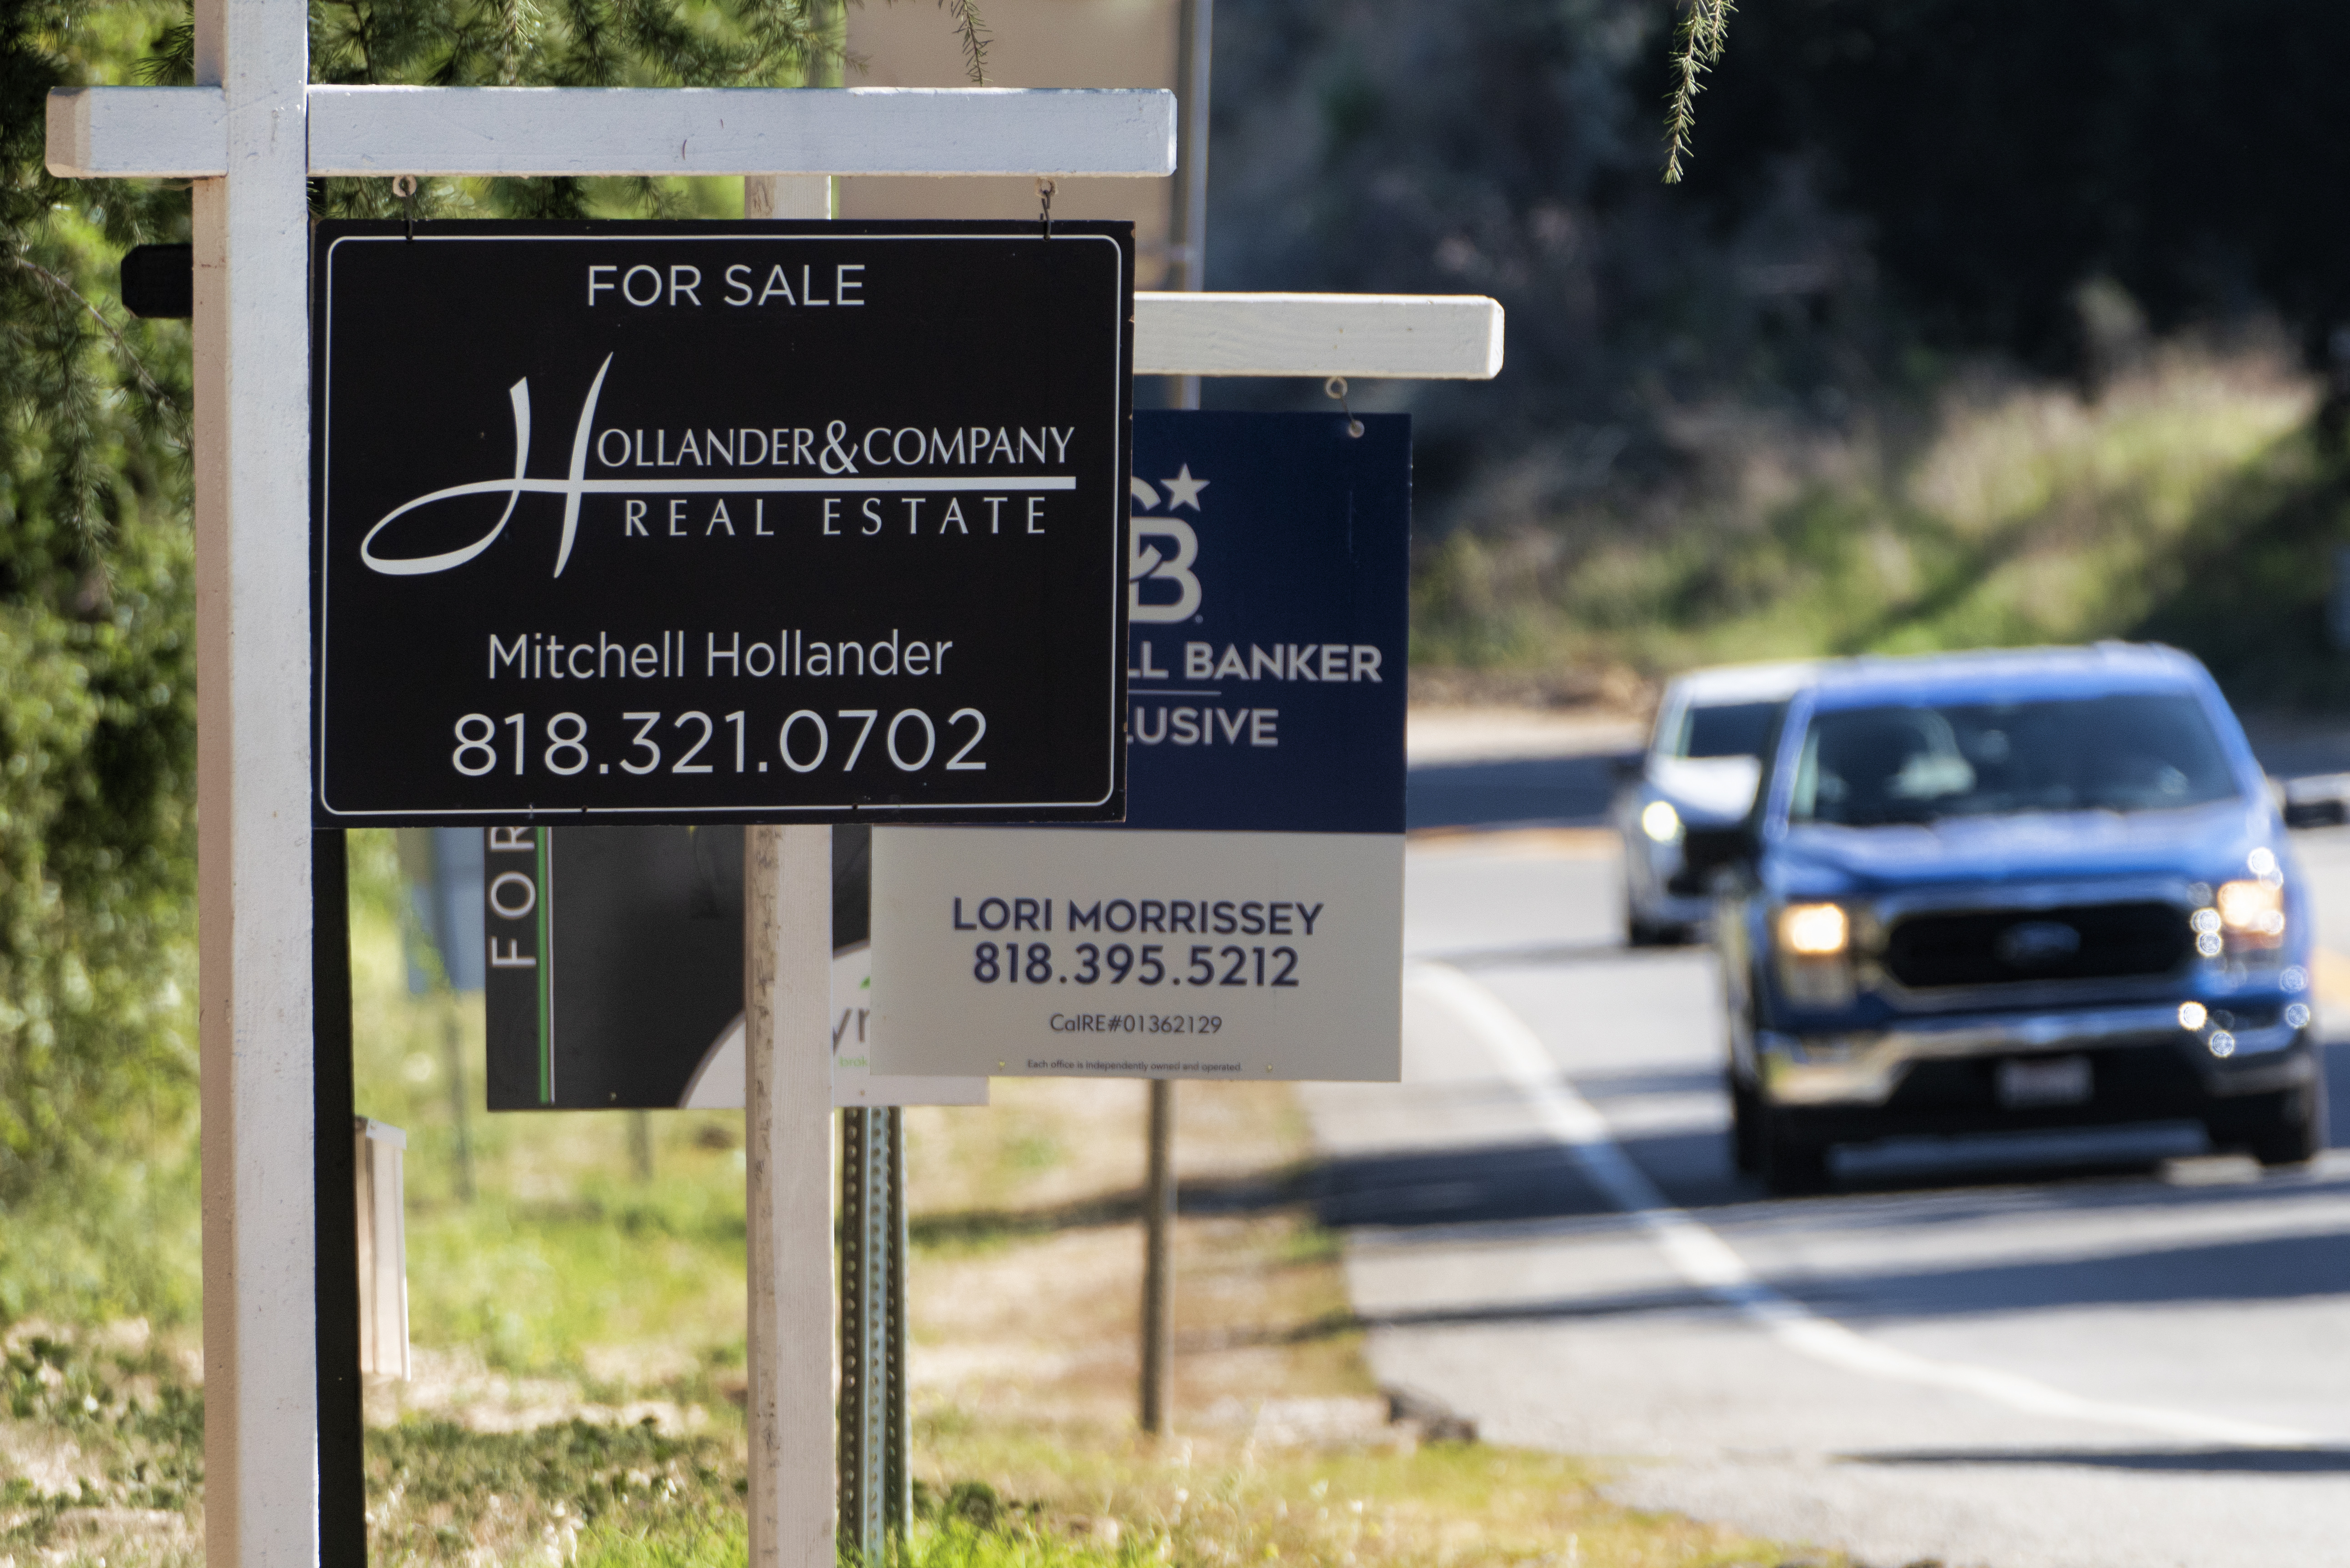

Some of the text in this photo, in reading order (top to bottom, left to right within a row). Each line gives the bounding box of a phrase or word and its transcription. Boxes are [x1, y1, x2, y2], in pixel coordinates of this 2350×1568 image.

[588, 264, 865, 307] FOR SALE
[625, 496, 1045, 537] REAL ESTATE
[489, 628, 953, 679] Mitchell Hollander
[1185, 642, 1383, 683] BANKER
[452, 707, 987, 777] 818.321.0702
[1128, 707, 1279, 747] USIVE
[490, 826, 537, 966] FOR
[953, 897, 1324, 936] LORI MORRISSEY
[973, 941, 1300, 987] 818.395.5212
[1049, 1012, 1223, 1035] CalRE#01362129
[1026, 1059, 1049, 1068] Each
[1050, 1059, 1075, 1069] office
[1076, 1060, 1084, 1069] is
[1085, 1060, 1149, 1072] independently
[1150, 1061, 1181, 1070] owned
[1182, 1061, 1200, 1070] and
